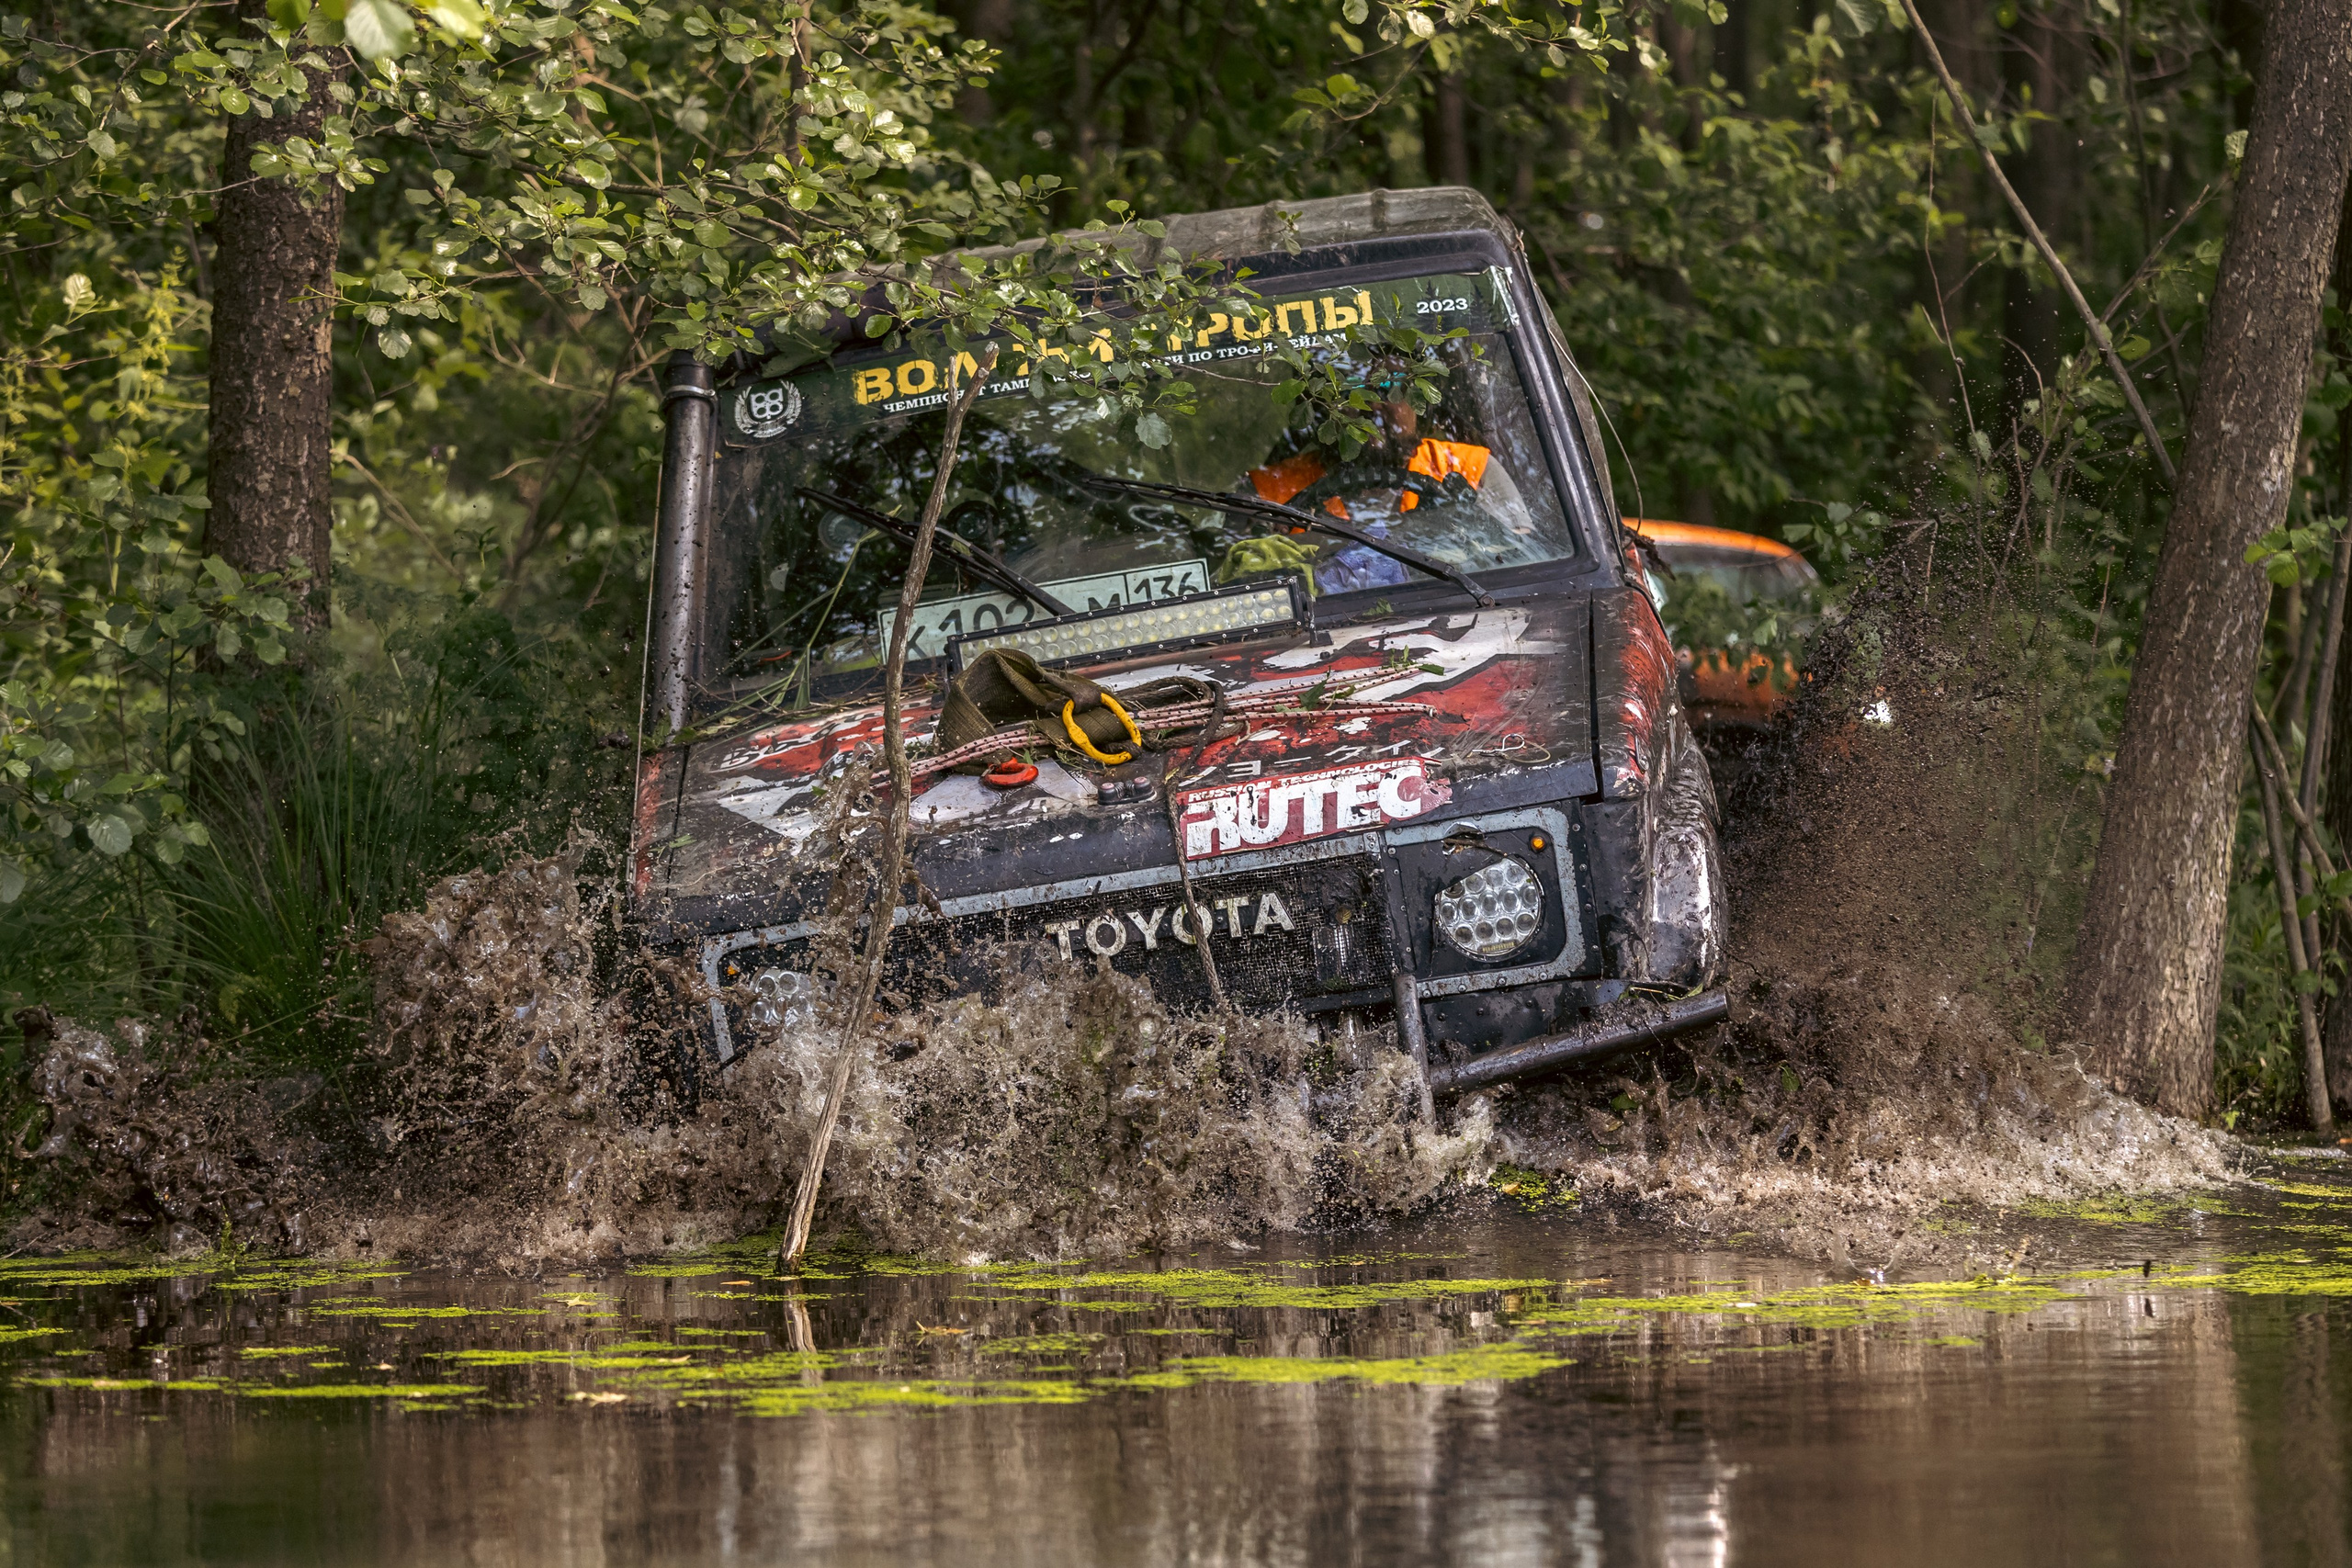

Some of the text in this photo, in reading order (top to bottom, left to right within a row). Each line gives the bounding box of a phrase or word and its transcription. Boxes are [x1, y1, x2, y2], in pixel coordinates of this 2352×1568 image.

[1416, 298, 1468, 314] 2023
[1188, 351, 1213, 363] ПО
[1133, 571, 1200, 603] 136
[1277, 759, 1421, 789] TECHNOLOGIES
[1186, 765, 1422, 857] RUTEC
[1044, 891, 1296, 962] TOYOTA
